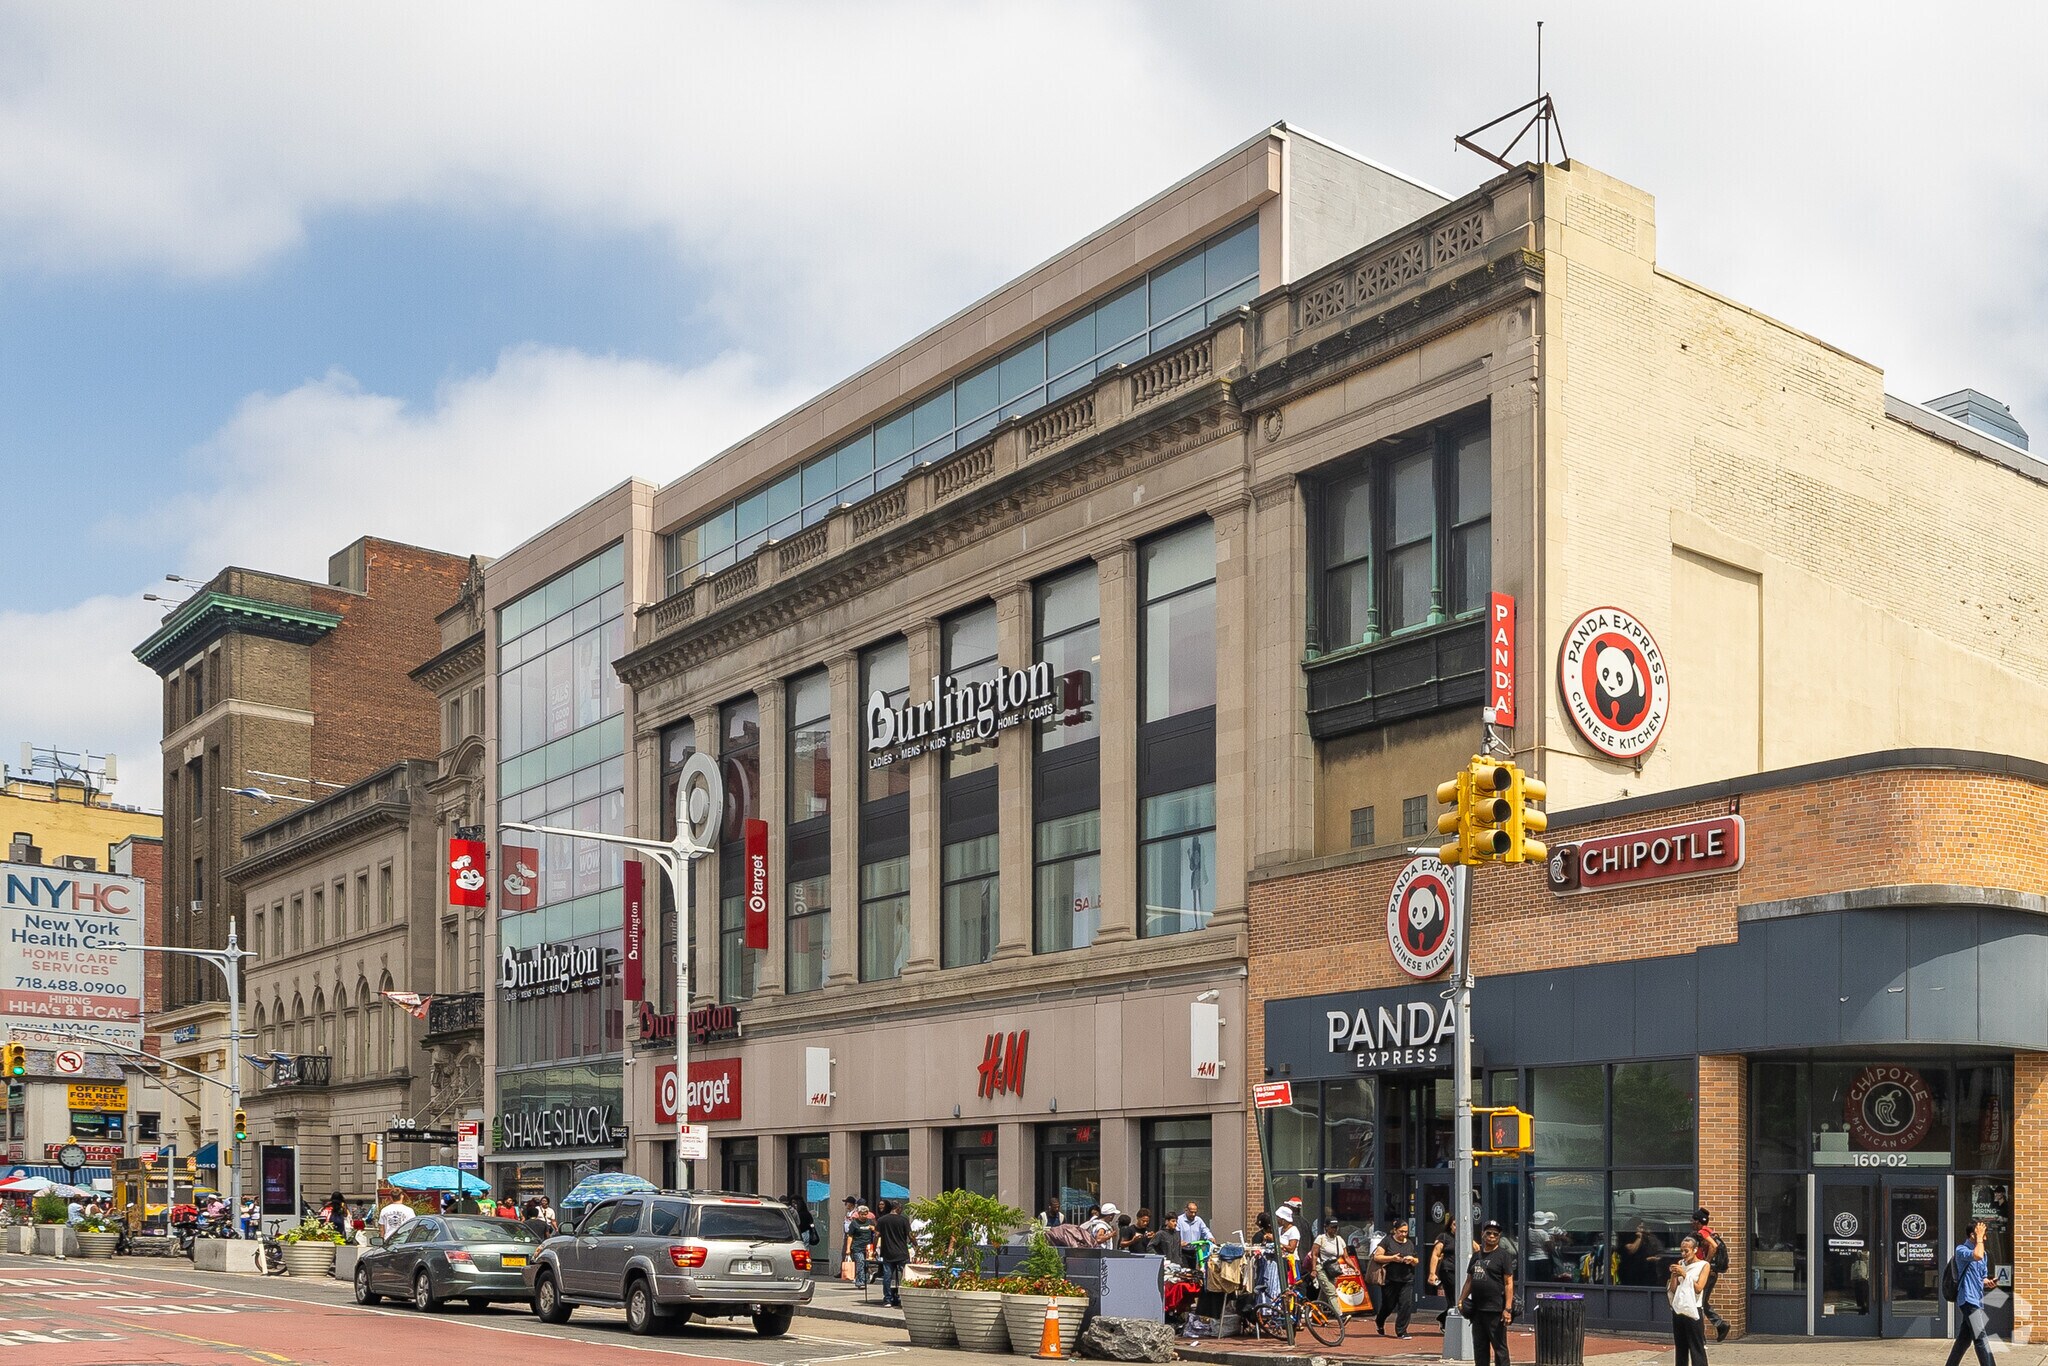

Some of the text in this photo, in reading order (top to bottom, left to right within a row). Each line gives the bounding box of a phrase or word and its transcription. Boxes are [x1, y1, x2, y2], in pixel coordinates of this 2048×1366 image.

[1495, 604, 1508, 714] PANDA
[1568, 614, 1664, 686] PANDA EXPRESS
[867, 661, 1052, 752] Burlington
[1572, 691, 1660, 749] CHINESE KITCHEN
[869, 703, 1054, 769] LADIES MENS KIDS BABY HOME COATS
[1582, 828, 1725, 876] CHIPOTLE
[752, 854, 764, 896] target
[1390, 859, 1455, 913] PANDA EXPRE
[7, 873, 131, 914] NYHC
[12, 928, 78, 949] Health
[25, 914, 120, 936] New York
[628, 902, 639, 960] Burlington
[22, 949, 118, 965] HOME CARE
[32, 961, 110, 976] SERVICES
[502, 943, 599, 993] Burlington
[1392, 935, 1422, 971] CHINESE
[15, 977, 127, 995] 718.488.0900
[48, 995, 92, 1006] HIRING
[9, 1001, 131, 1020] HHA's & PCA's
[1326, 999, 1455, 1053] PANDA
[111, 1038, 134, 1048] Ave
[1356, 1047, 1437, 1068] EXPRESS
[977, 1029, 1030, 1099] H&M
[1197, 1061, 1216, 1077] H&M
[75, 1085, 120, 1094] OFFICE
[96, 1092, 125, 1100] RENT
[686, 1072, 730, 1113] arget
[811, 1093, 828, 1105] H&M
[1851, 1067, 1929, 1101] CHIPOTLE
[503, 1111, 552, 1148] SHAKE
[554, 1105, 611, 1146] SHACK
[1852, 1116, 1926, 1148] MEXICAN GRILL
[1853, 1153, 1907, 1167] 160-02
[1998, 1268, 2009, 1280] A
